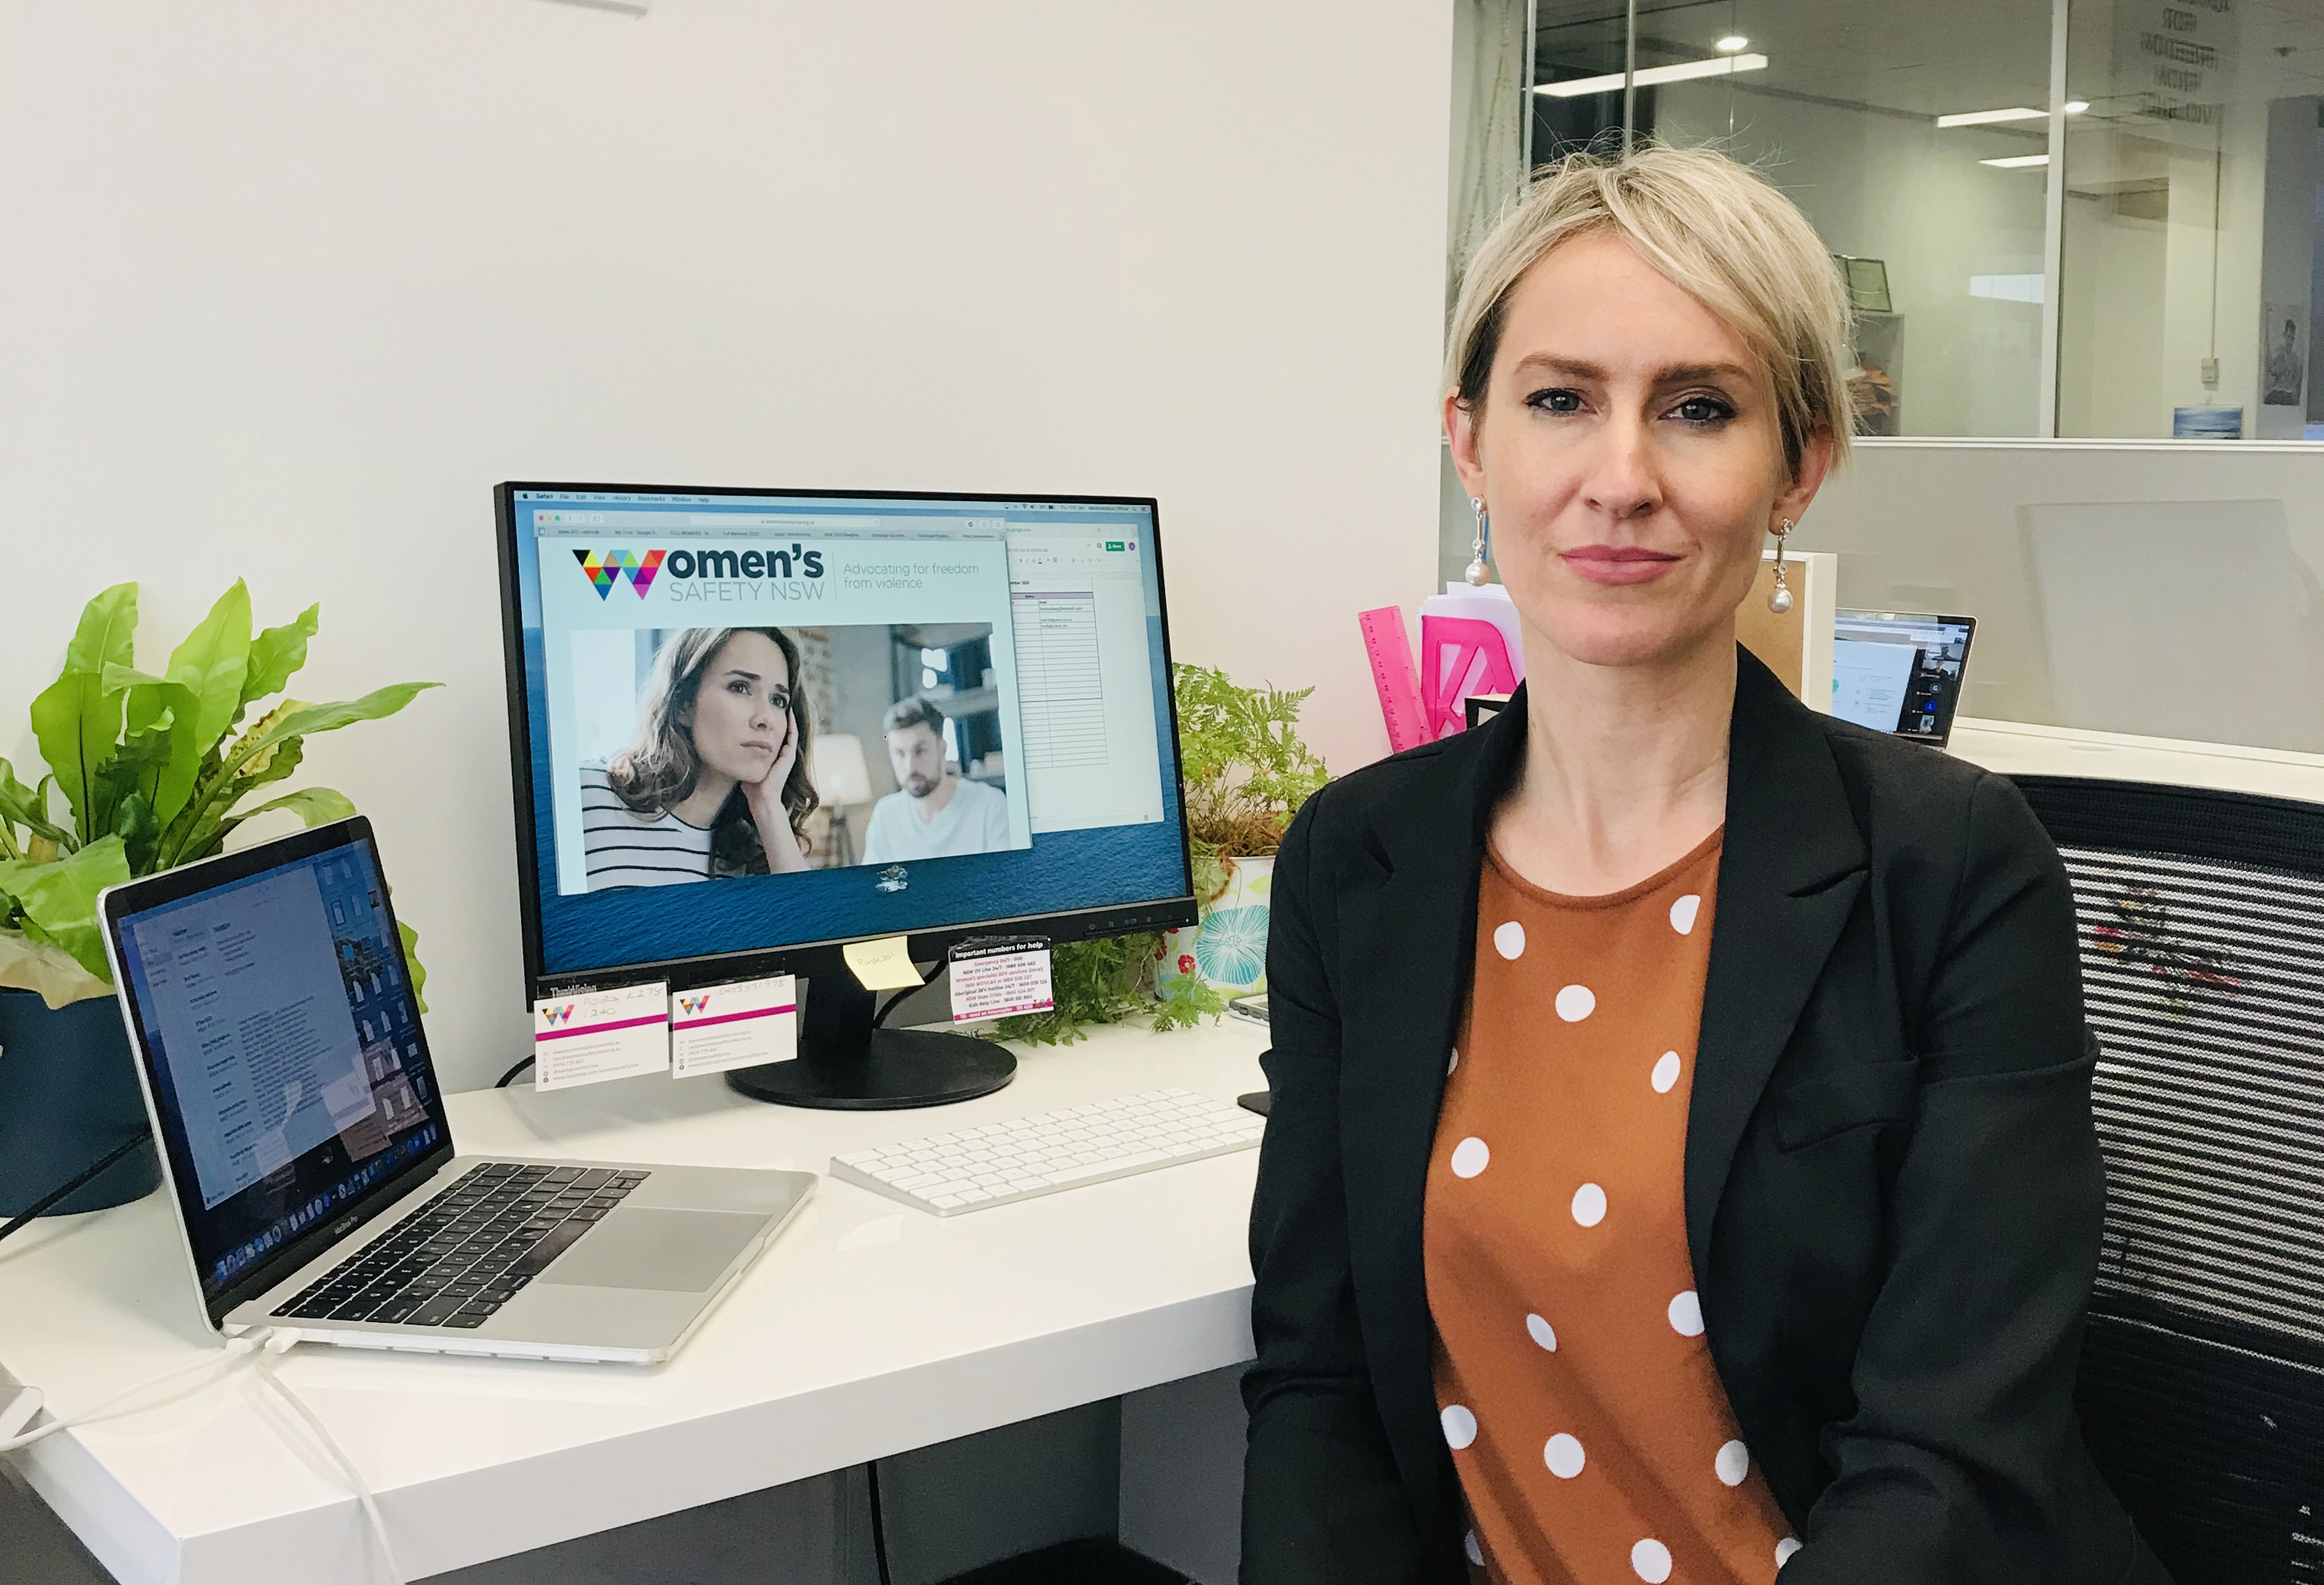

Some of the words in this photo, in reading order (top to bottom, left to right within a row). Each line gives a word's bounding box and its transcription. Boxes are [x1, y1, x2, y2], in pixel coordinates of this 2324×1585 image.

[843, 563, 911, 577] Advocating
[913, 563, 930, 575] for
[932, 563, 980, 575] freedom
[844, 577, 873, 590] from
[875, 577, 923, 590] violence
[669, 581, 763, 601] SAFETY
[771, 581, 825, 601] NSW
[955, 948, 987, 959] Important
[988, 945, 1016, 954] numbers
